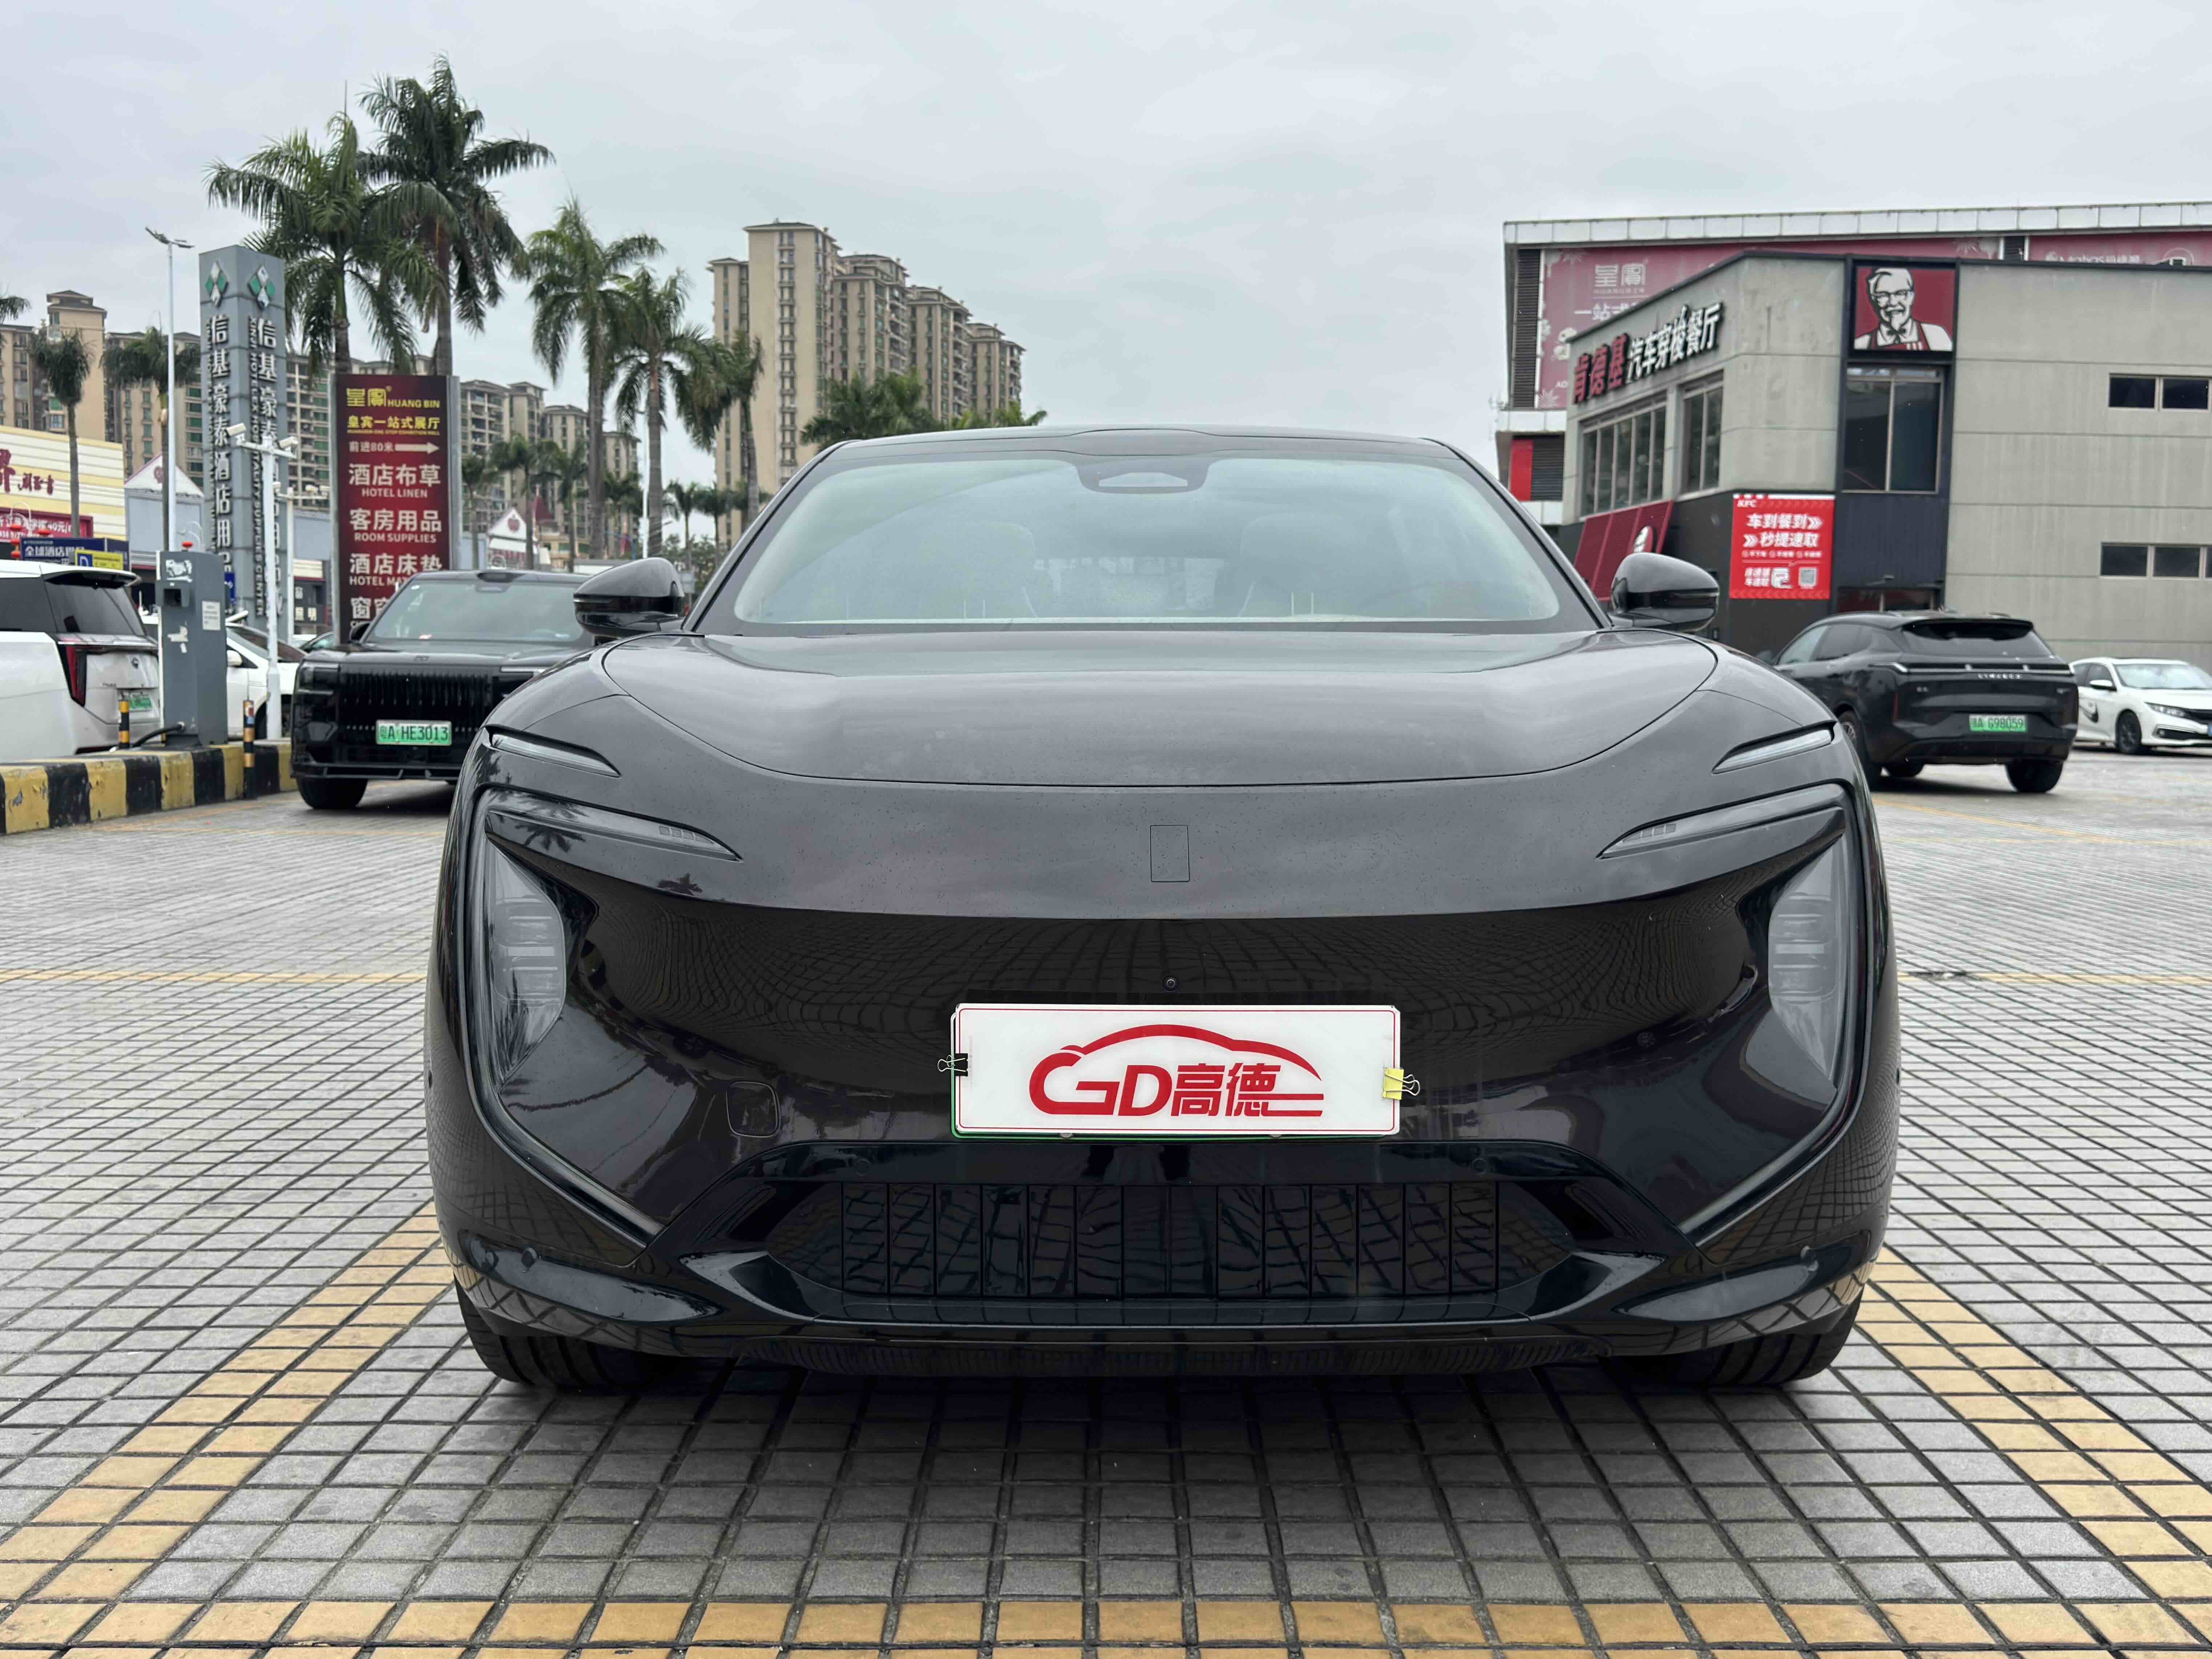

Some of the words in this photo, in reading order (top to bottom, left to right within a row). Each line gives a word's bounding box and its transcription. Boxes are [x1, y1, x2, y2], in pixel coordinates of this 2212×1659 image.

[387, 400, 423, 408] HUANG
[424, 400, 440, 408] BIN
[348, 463, 441, 487] 酒店布草
[362, 488, 396, 497] HOTEL
[397, 489, 428, 498] LINEN
[349, 508, 442, 532] 客房用品
[354, 533, 386, 542] ROOM
[387, 534, 437, 543] SUPPLIES
[349, 553, 443, 575] 酒店床垫
[349, 576, 385, 586] HOTEL
